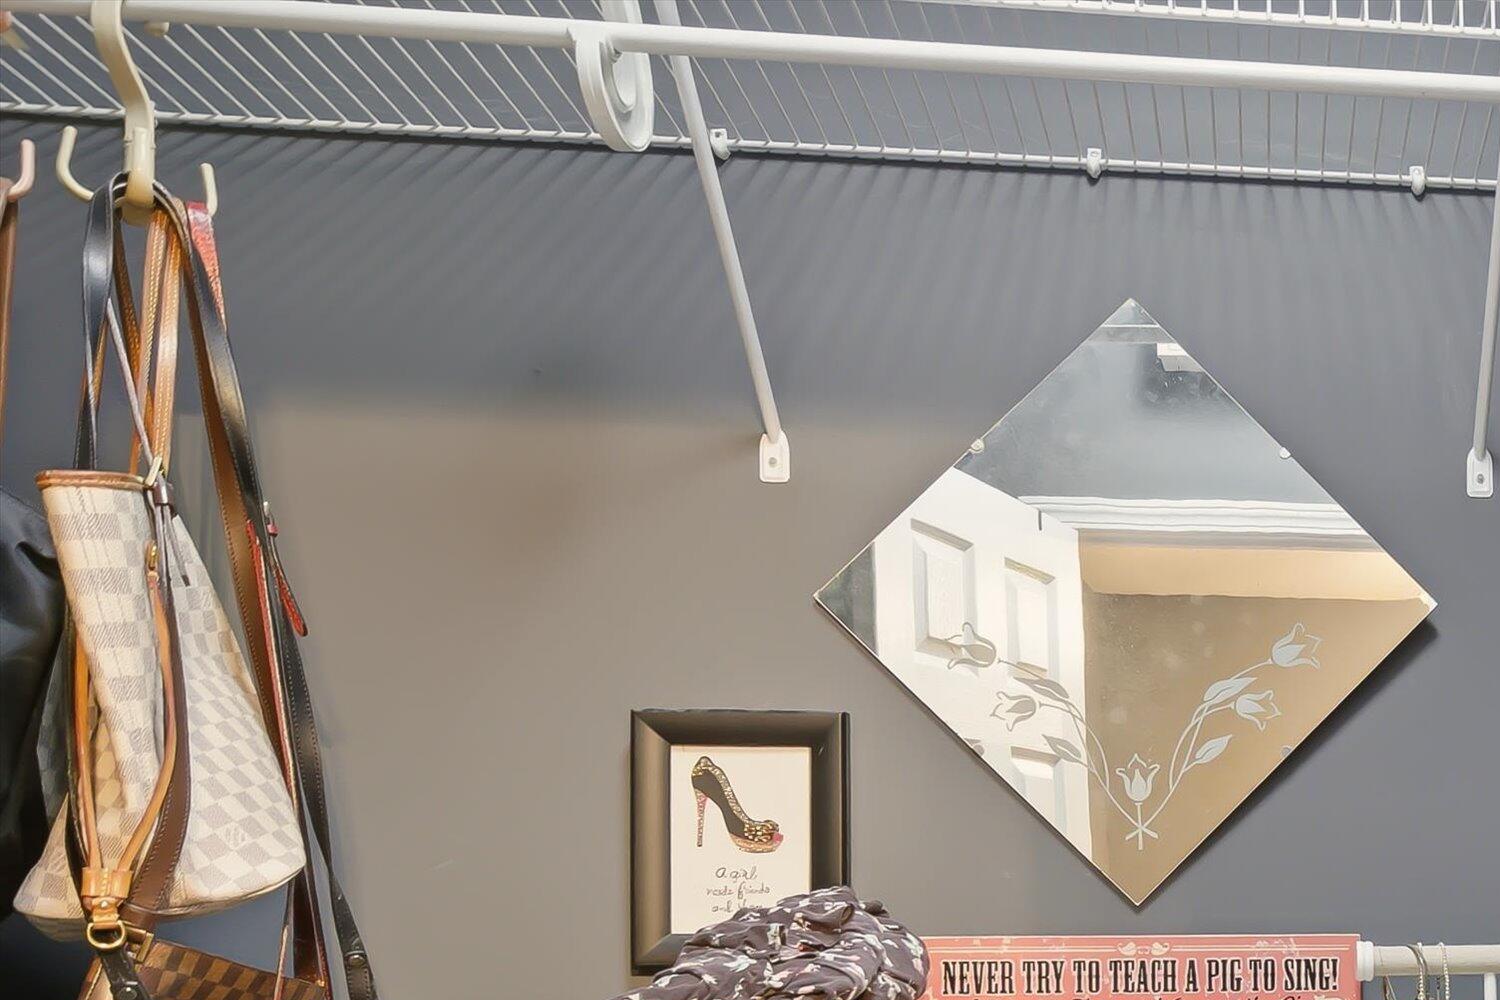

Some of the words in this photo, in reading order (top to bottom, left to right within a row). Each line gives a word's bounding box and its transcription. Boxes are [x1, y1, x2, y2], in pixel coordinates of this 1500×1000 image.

[942, 960, 1015, 995] NEVER
[1022, 960, 1065, 994] TRY
[1073, 960, 1101, 993] TO
[1109, 959, 1177, 993] TEACH
[1185, 959, 1199, 992] A
[1206, 959, 1243, 992] PIG
[1249, 958, 1275, 992] TO
[1284, 958, 1338, 992] SING!
